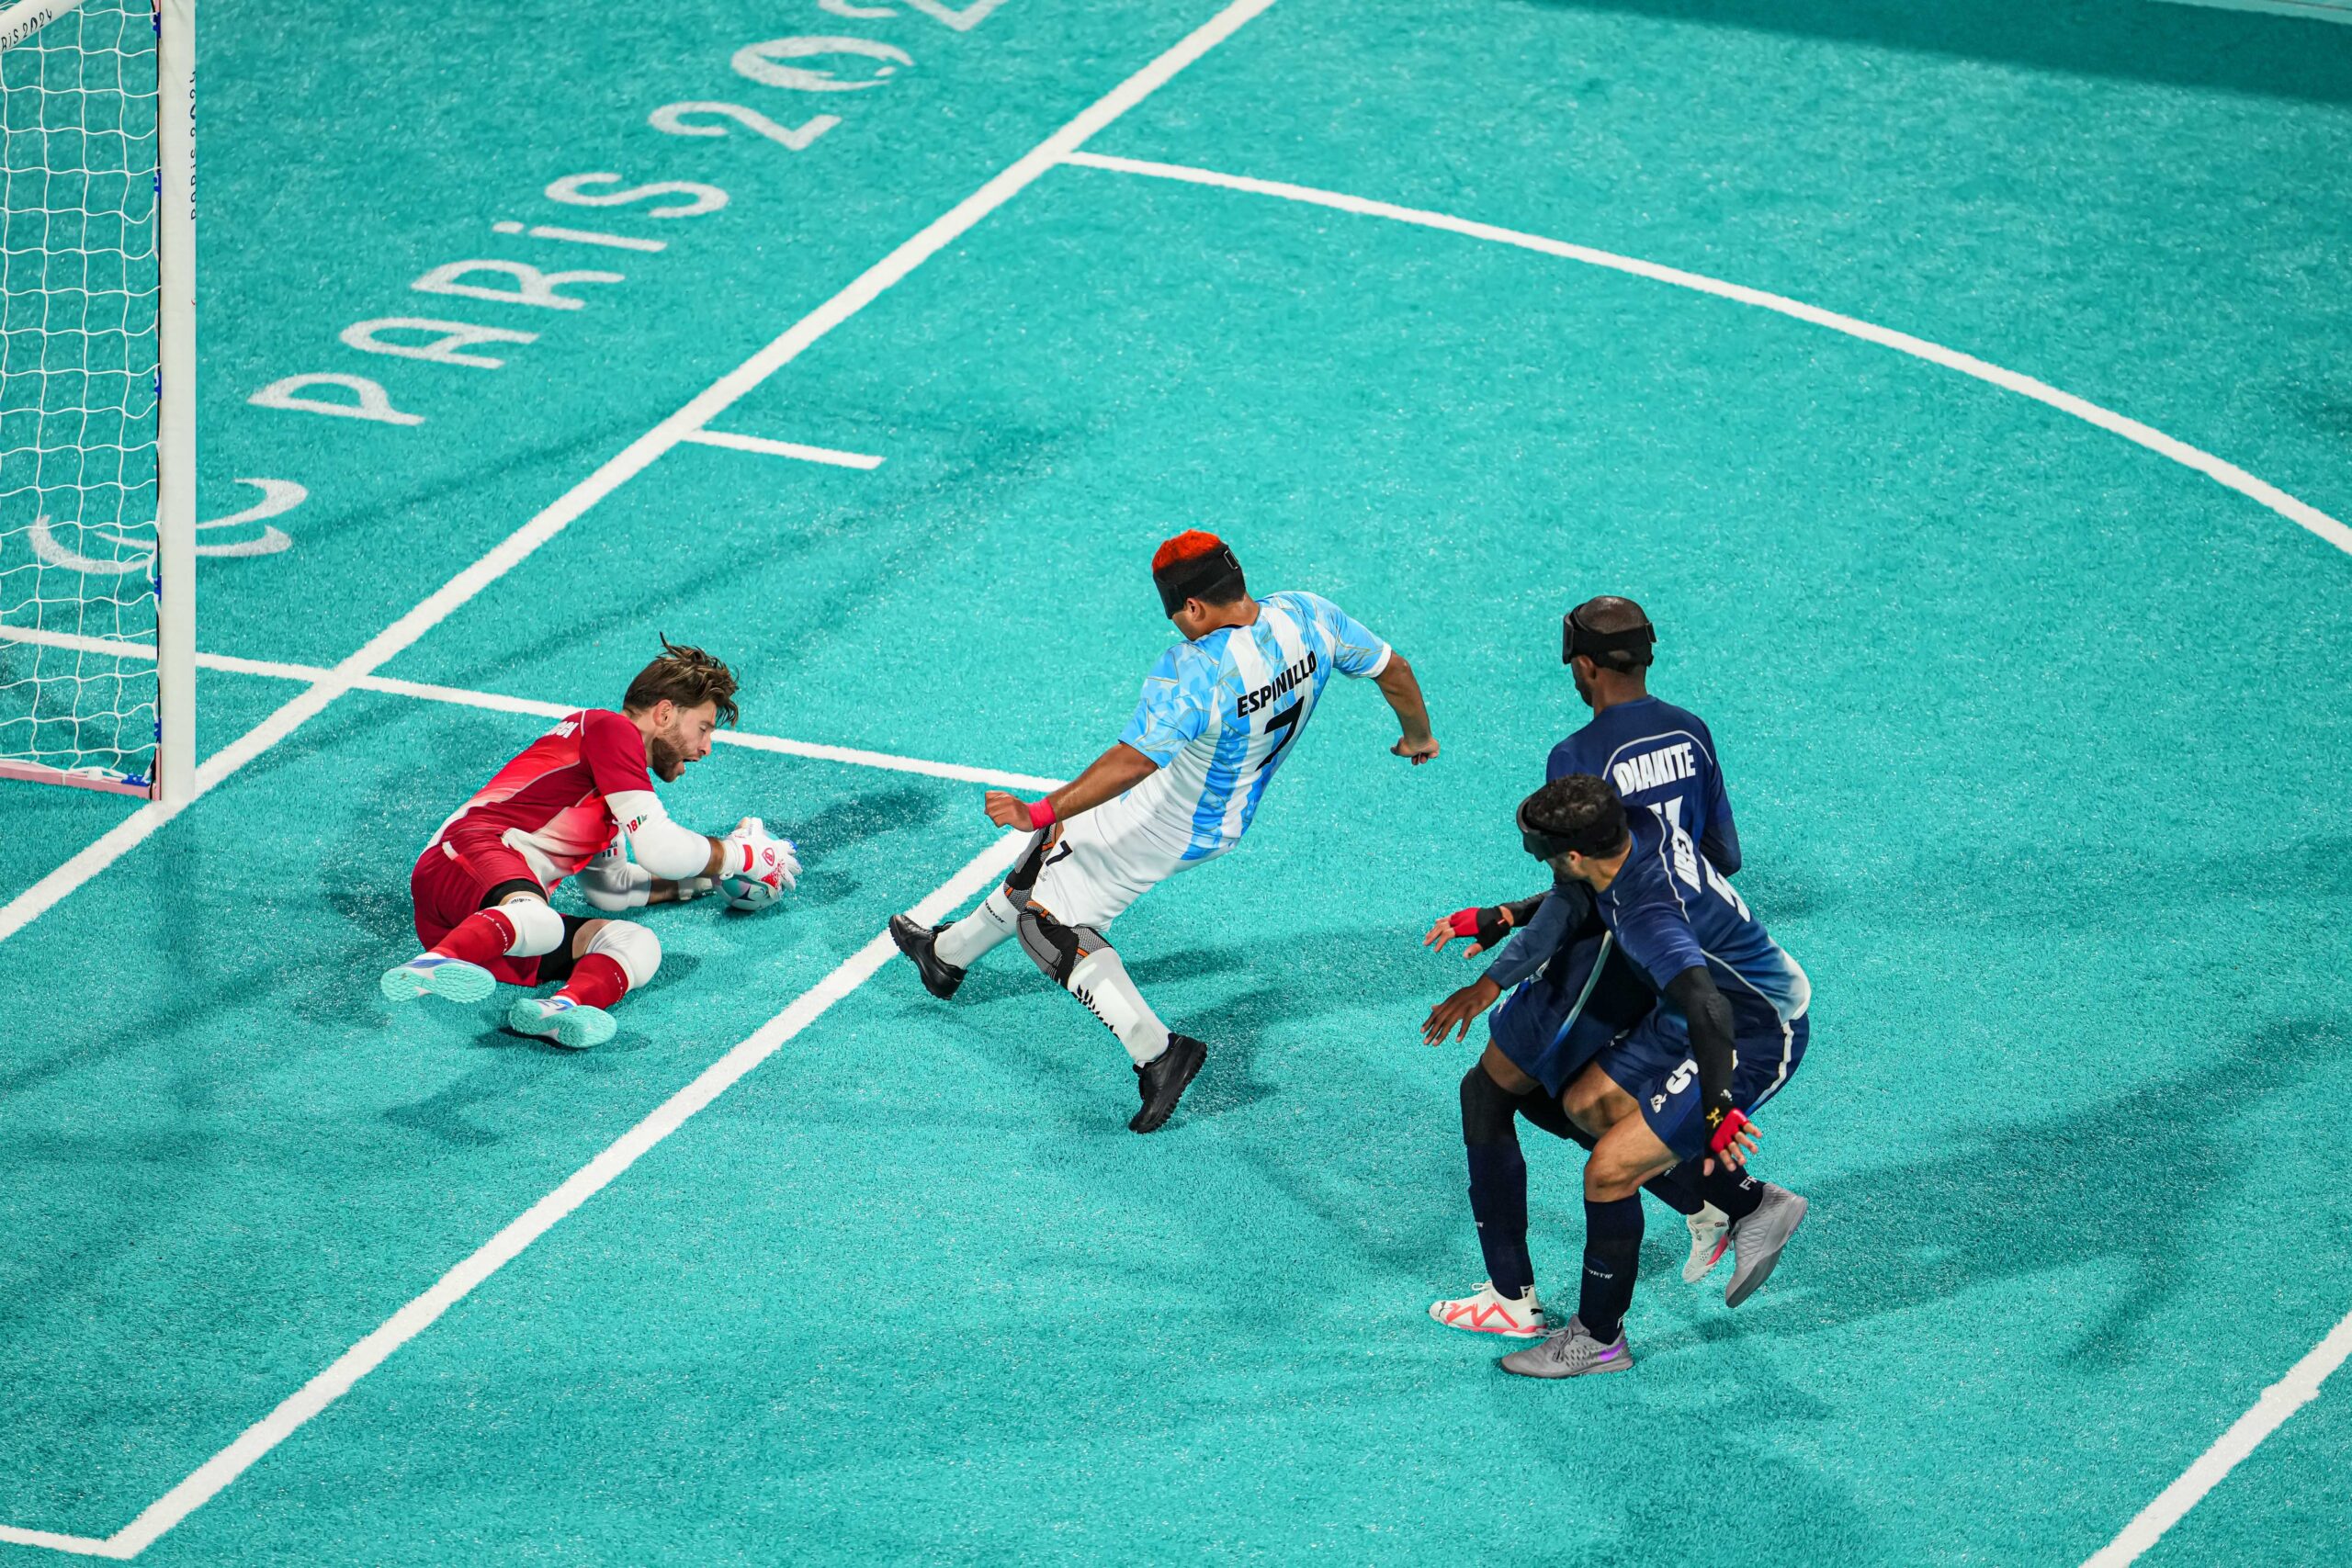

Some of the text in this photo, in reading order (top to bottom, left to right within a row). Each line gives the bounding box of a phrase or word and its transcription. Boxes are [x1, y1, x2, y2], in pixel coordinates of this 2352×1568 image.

[1237, 650, 1317, 718] ESPINILLO
[1254, 695, 1305, 773] 7
[1612, 741, 1697, 797] DIAKITE
[1046, 840, 1073, 867] 7
[1666, 1058, 1699, 1094] 5
